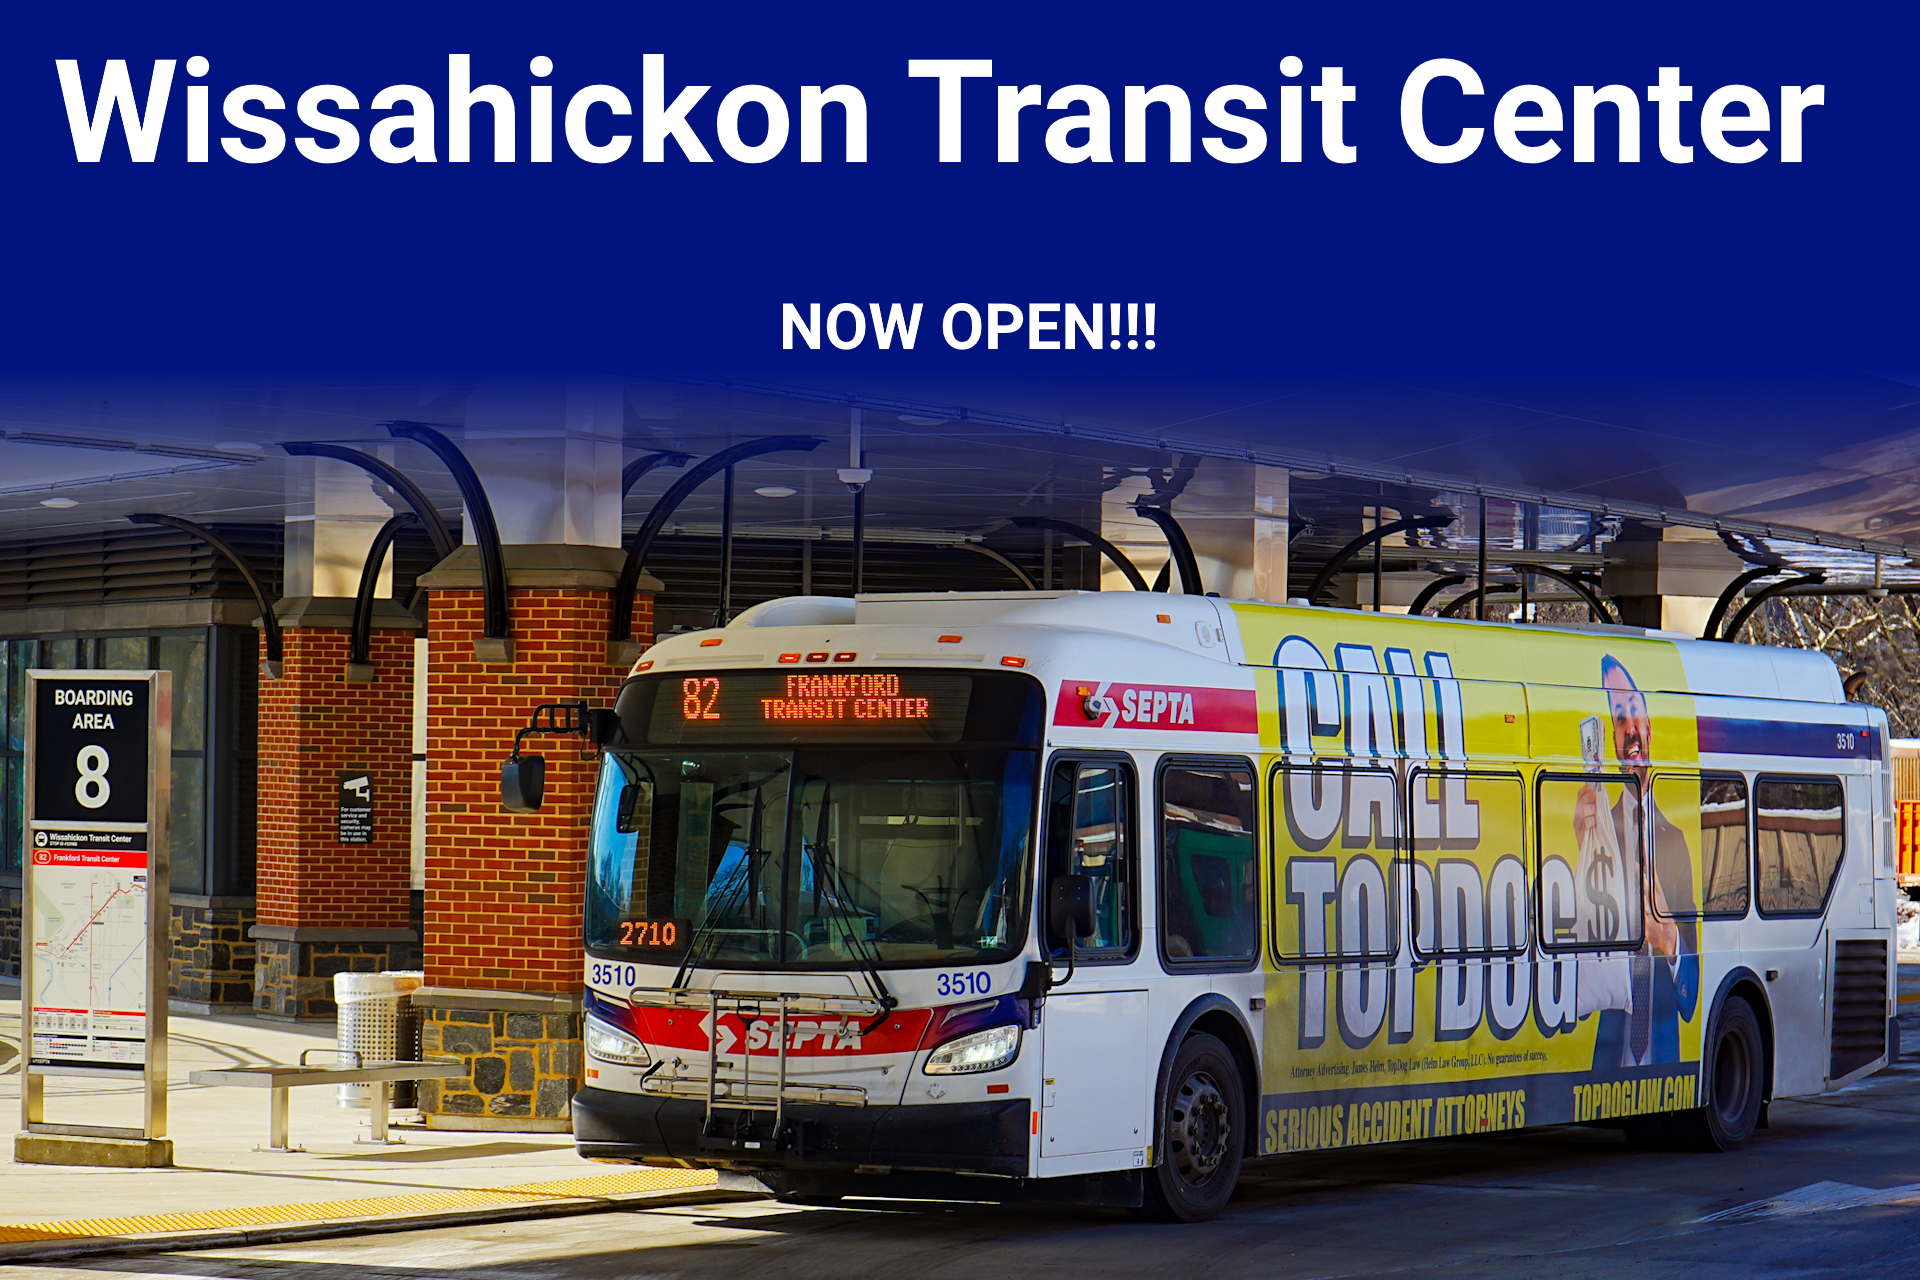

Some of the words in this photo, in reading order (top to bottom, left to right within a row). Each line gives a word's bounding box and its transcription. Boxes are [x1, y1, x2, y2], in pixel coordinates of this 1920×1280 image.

[54, 689, 134, 706] BOARDING
[786, 674, 899, 697] FRANKFORD
[683, 677, 721, 720] 82
[760, 698, 846, 719] TRANSIT
[854, 698, 929, 719] CENTER
[1121, 688, 1195, 724] SEPTA
[72, 713, 115, 730] AREA
[1274, 635, 1479, 851] CALL
[1836, 732, 1855, 750] 3510
[75, 744, 111, 809] 8
[49, 833, 88, 842] Wissahickon
[89, 834, 110, 843] Transit
[110, 834, 133, 844] Center
[38, 853, 48, 861] 82
[53, 854, 81, 862] Frankford
[81, 854, 101, 863] Transit
[101, 855, 120, 863] Center
[620, 922, 676, 946] 2710
[1286, 854, 1577, 1050] TOPDOG
[592, 963, 637, 987] 3510
[937, 971, 992, 996] 3510
[748, 1019, 862, 1051] SEPTA
[1291, 1065, 1315, 1079] Attorney
[1352, 1061, 1369, 1075] James
[1387, 1058, 1408, 1074] TopDog
[1409, 1057, 1420, 1071] Law
[1422, 1057, 1438, 1071] (Helm
[1439, 1056, 1450, 1069] Law
[1487, 1052, 1495, 1065] No
[1495, 1051, 1523, 1067] guarantees
[1523, 1050, 1530, 1062] of
[1573, 1074, 1697, 1122] TOPDOGLAW.COM
[1265, 1102, 1344, 1153] SERIOUS
[1347, 1095, 1433, 1146] ACCIDENT
[1434, 1088, 1527, 1139] ATTORNEYS
